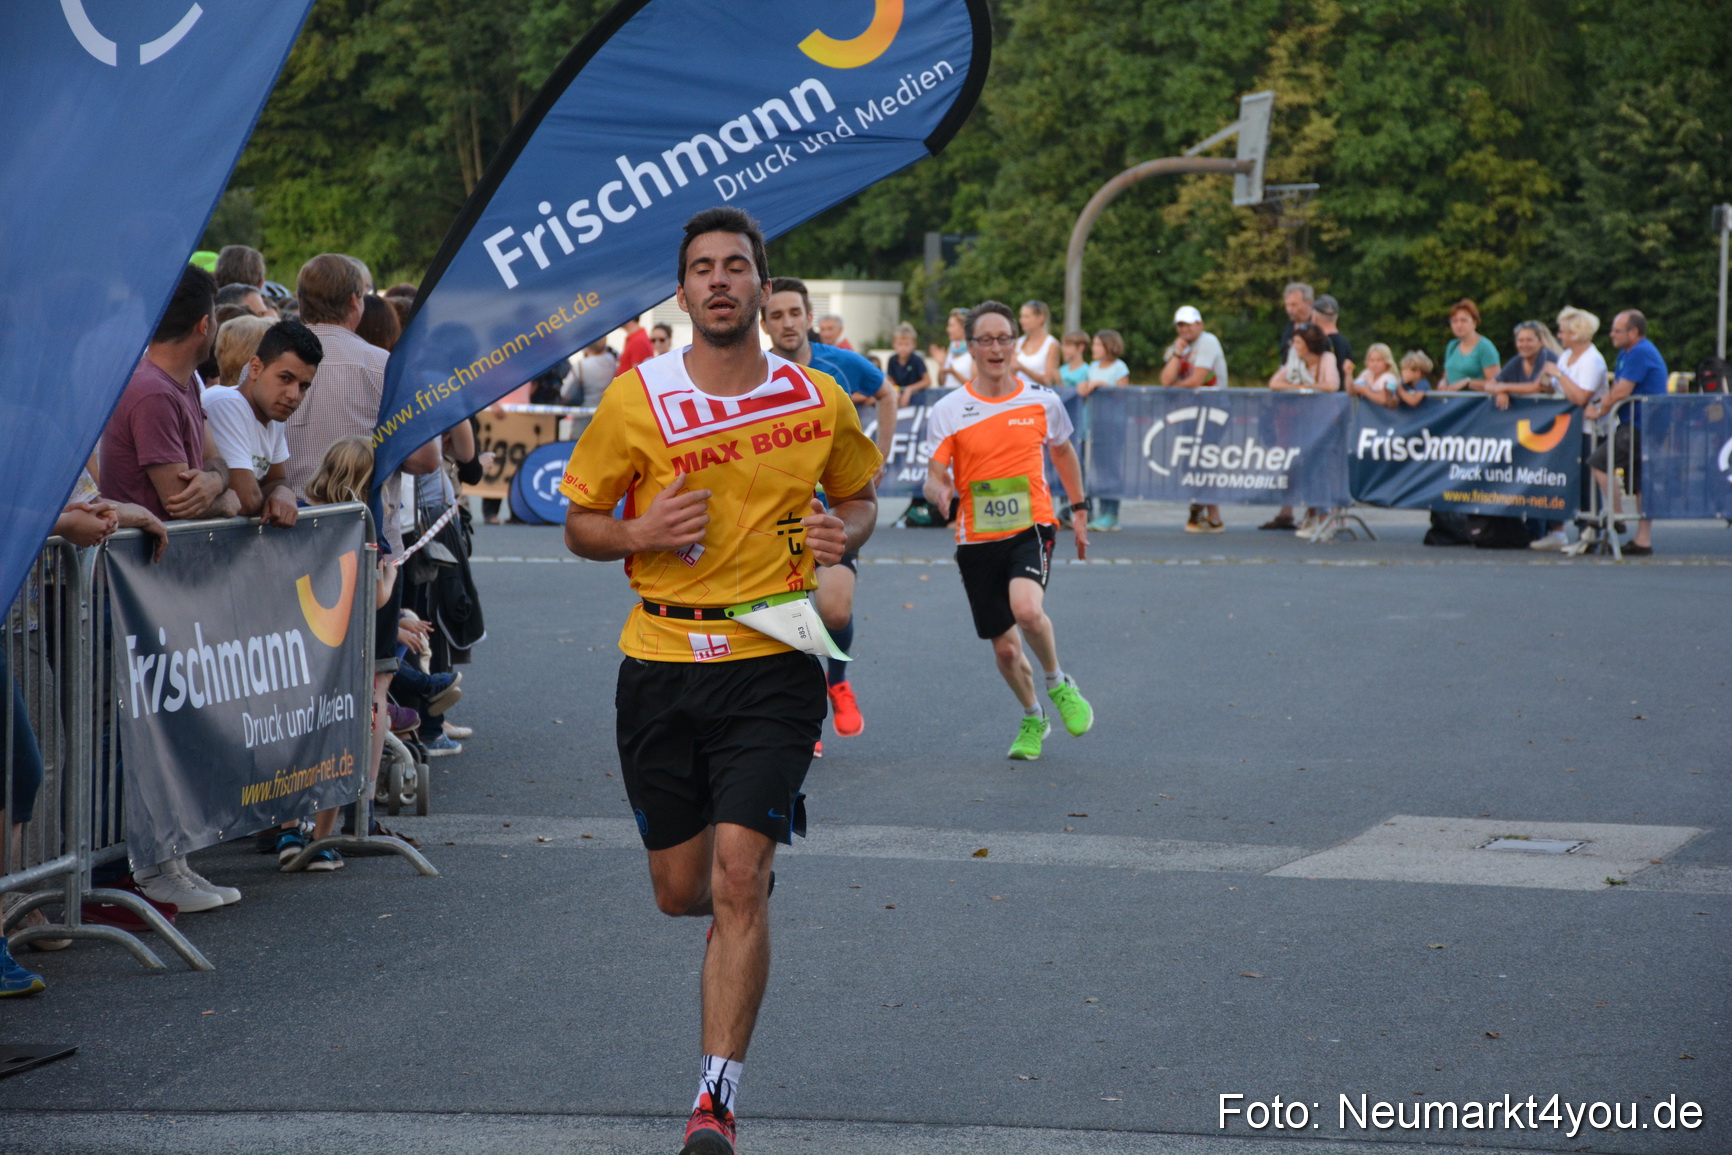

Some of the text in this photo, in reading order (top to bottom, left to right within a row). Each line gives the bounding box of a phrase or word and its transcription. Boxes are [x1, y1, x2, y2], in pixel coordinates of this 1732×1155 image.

[713, 59, 954, 202] Druck und Medien
[483, 77, 837, 290] Frischmann
[670, 419, 832, 477] MAX BÖGL
[1170, 436, 1301, 471] Fischer
[1357, 428, 1513, 464] Frischmann
[1181, 472, 1289, 490] AUTOMOBILE
[1449, 463, 1567, 487] Druck und Medien
[984, 498, 1019, 518] 490
[1442, 489, 1566, 510] www.frischmann-net.de
[125, 622, 311, 719] Frischmann
[242, 704, 284, 748] Druck
[286, 695, 315, 738] und
